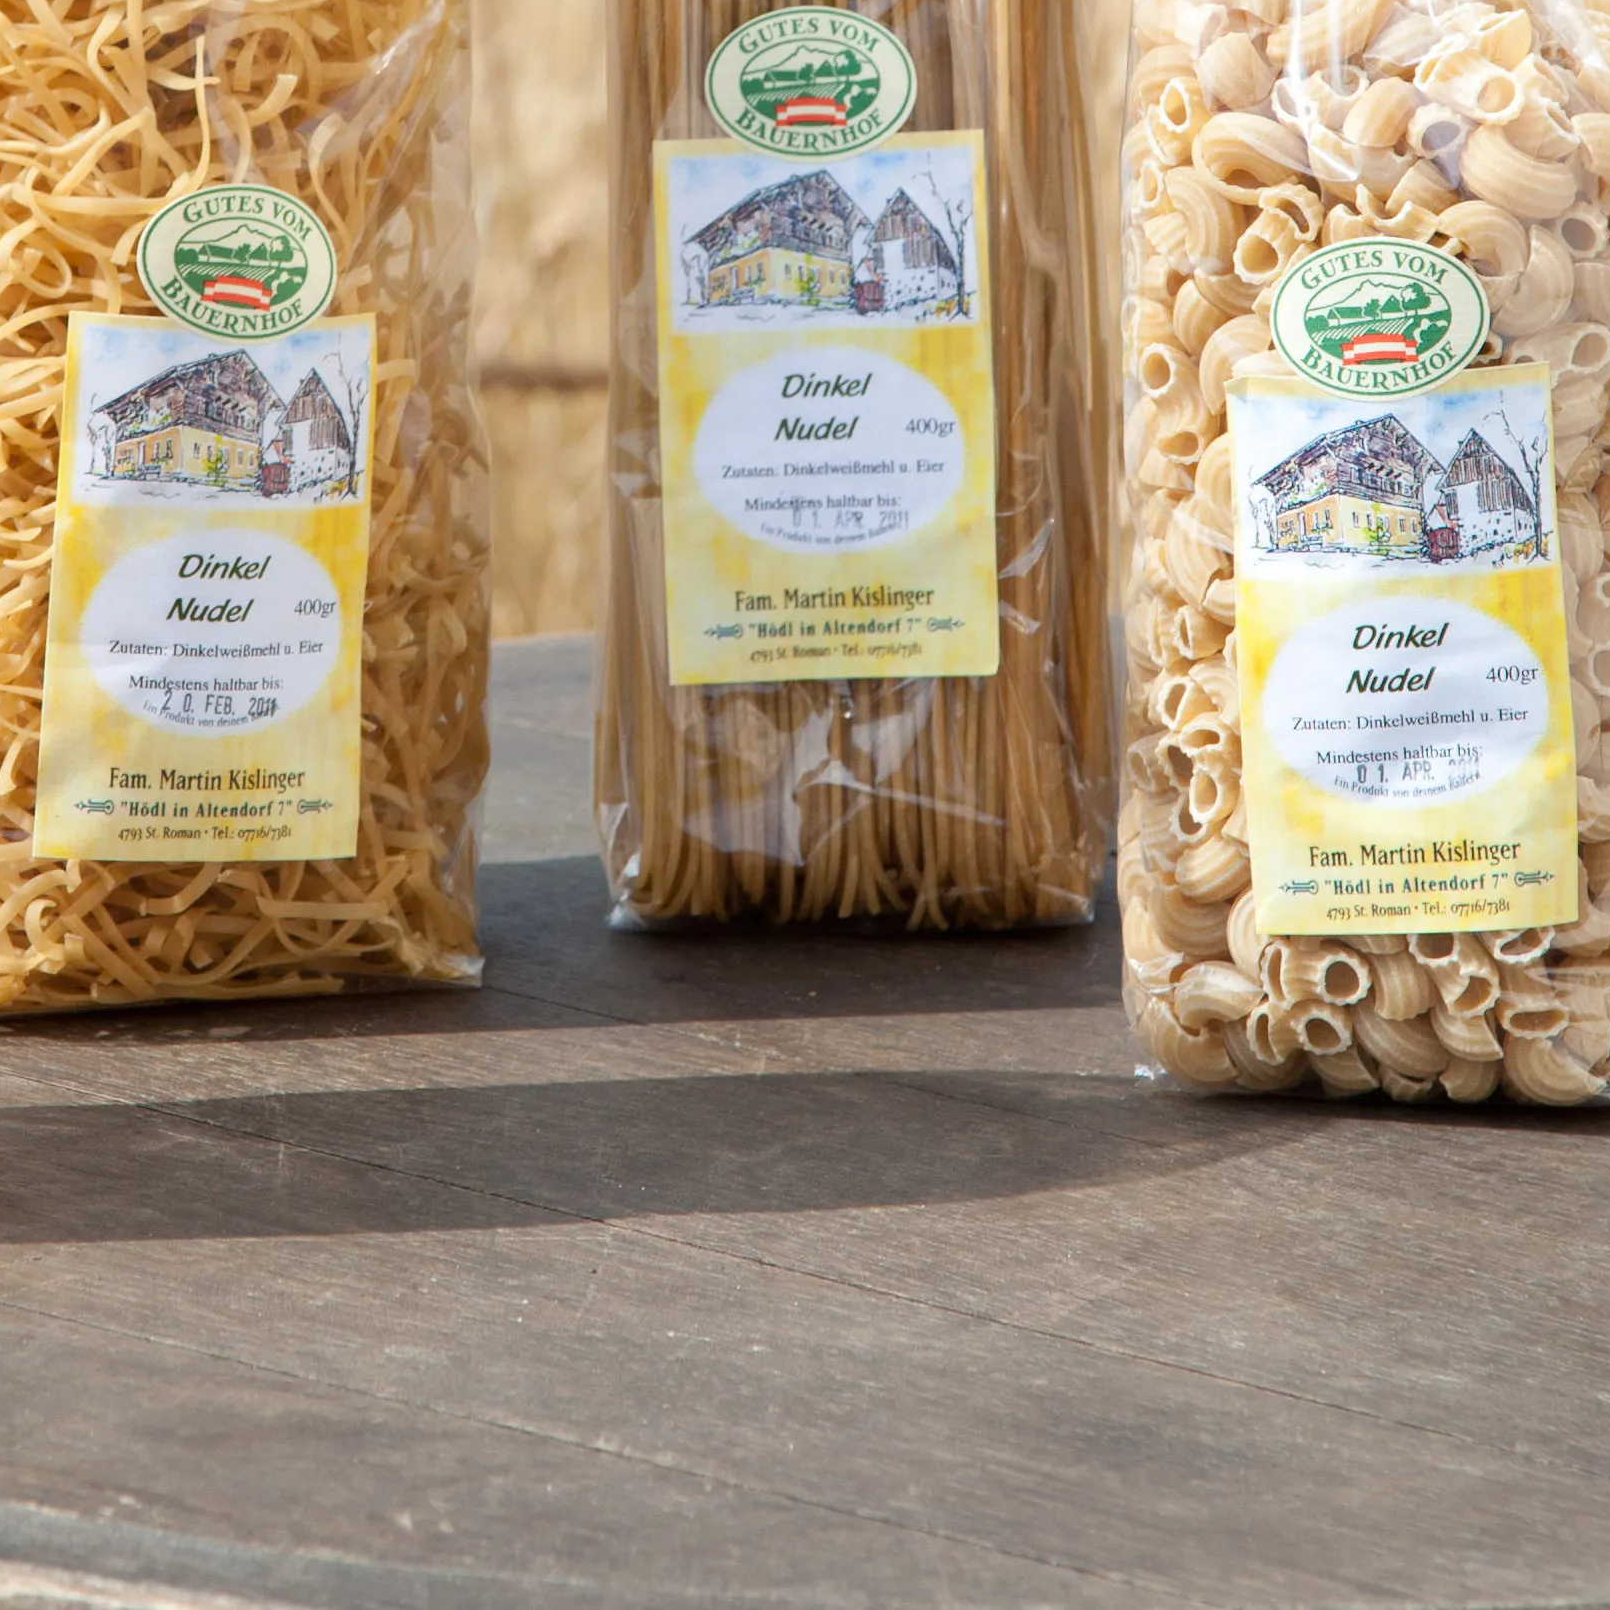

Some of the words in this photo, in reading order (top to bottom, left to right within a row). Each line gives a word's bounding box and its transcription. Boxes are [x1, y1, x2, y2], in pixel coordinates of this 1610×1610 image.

[739, 17, 819, 54] GUTES
[829, 19, 880, 53] VOM
[735, 107, 884, 152] BAUERNHOF
[183, 195, 265, 223] GUTES
[272, 202, 312, 240] VOM
[1301, 250, 1383, 290] GUTES
[1392, 251, 1448, 285] VOM
[161, 275, 303, 334] BAUERNHOF
[1301, 341, 1457, 390] BAUERNHOF
[781, 372, 873, 398] Dinkel
[773, 416, 859, 441] Nudel
[905, 417, 956, 437] 400gr
[722, 465, 778, 479] Zutaten:
[917, 460, 945, 473] Eier
[178, 554, 272, 579] Dinkel
[166, 597, 254, 622] Nudel
[294, 599, 336, 618] 400gr
[735, 591, 777, 612] Fam.
[784, 589, 846, 610] Martin
[852, 585, 935, 612] Kislinger
[800, 623, 815, 636] in
[823, 618, 901, 637] Altendorf
[1353, 622, 1450, 650] Dinkel
[109, 640, 168, 656] Zutaten:
[173, 641, 280, 658] Dinkelweißmehl
[284, 646, 294, 655] u.
[299, 641, 323, 654] Eier
[129, 676, 209, 691] Mindestens
[214, 677, 259, 692] haltbar
[262, 677, 283, 690] bis:
[1346, 666, 1437, 694] Nudel
[1486, 665, 1539, 686] 400gr
[205, 694, 235, 716] FEB.
[1292, 717, 1351, 730] Zutaten:
[1357, 710, 1475, 729] Dinkelweißmehl
[1480, 711, 1493, 722] u.
[1498, 708, 1529, 721] Eier
[1316, 749, 1399, 765] Mindestens
[1403, 744, 1454, 759] haltbar
[1457, 743, 1483, 757] bis:
[109, 767, 151, 789] Fam.
[160, 769, 222, 791] Martin
[228, 768, 305, 794] Kislinger
[1402, 761, 1434, 781] APR.
[174, 803, 189, 817] in
[195, 801, 274, 818] Altendorf
[118, 827, 142, 841] 4793
[145, 827, 158, 839] St.
[163, 827, 201, 839] Roman
[212, 827, 234, 838] Tel.:
[238, 827, 291, 841] 07716/7381
[1309, 846, 1353, 867] Fam.
[1361, 844, 1425, 865] Martin
[1433, 839, 1521, 865] Kislinger
[1379, 880, 1395, 893] in
[1402, 874, 1485, 893] Altendorf
[1326, 907, 1351, 921] 4793
[1354, 905, 1367, 917] St.
[1371, 904, 1411, 917] Roman
[1422, 902, 1446, 915] Tel.:
[1450, 898, 1510, 917] 07716/7381
